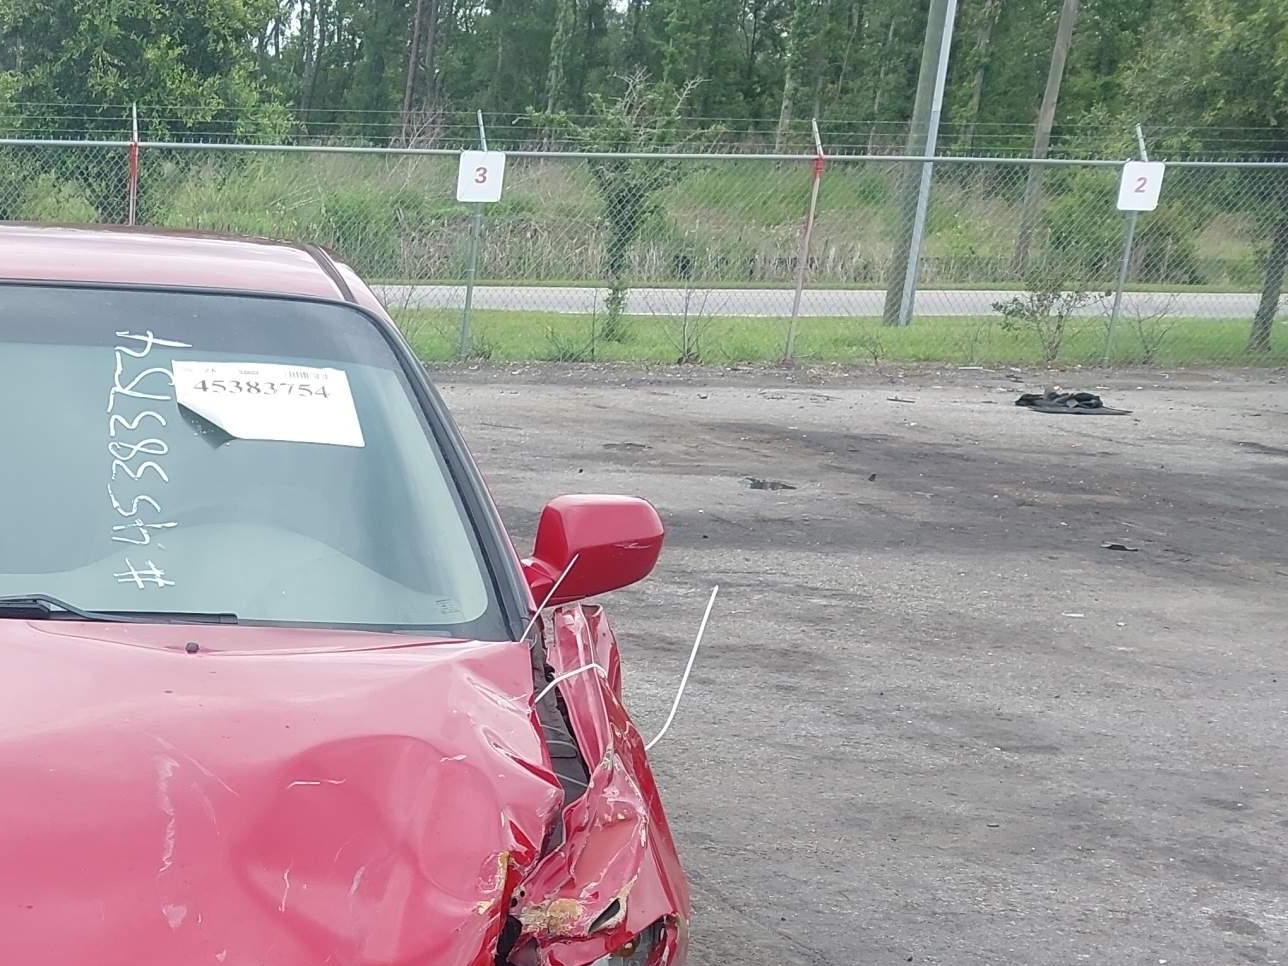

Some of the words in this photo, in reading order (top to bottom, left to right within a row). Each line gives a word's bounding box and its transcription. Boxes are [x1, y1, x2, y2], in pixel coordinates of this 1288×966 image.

[474, 166, 488, 184] 3
[1134, 176, 1148, 193] 2
[193, 379, 330, 399] 45383754
